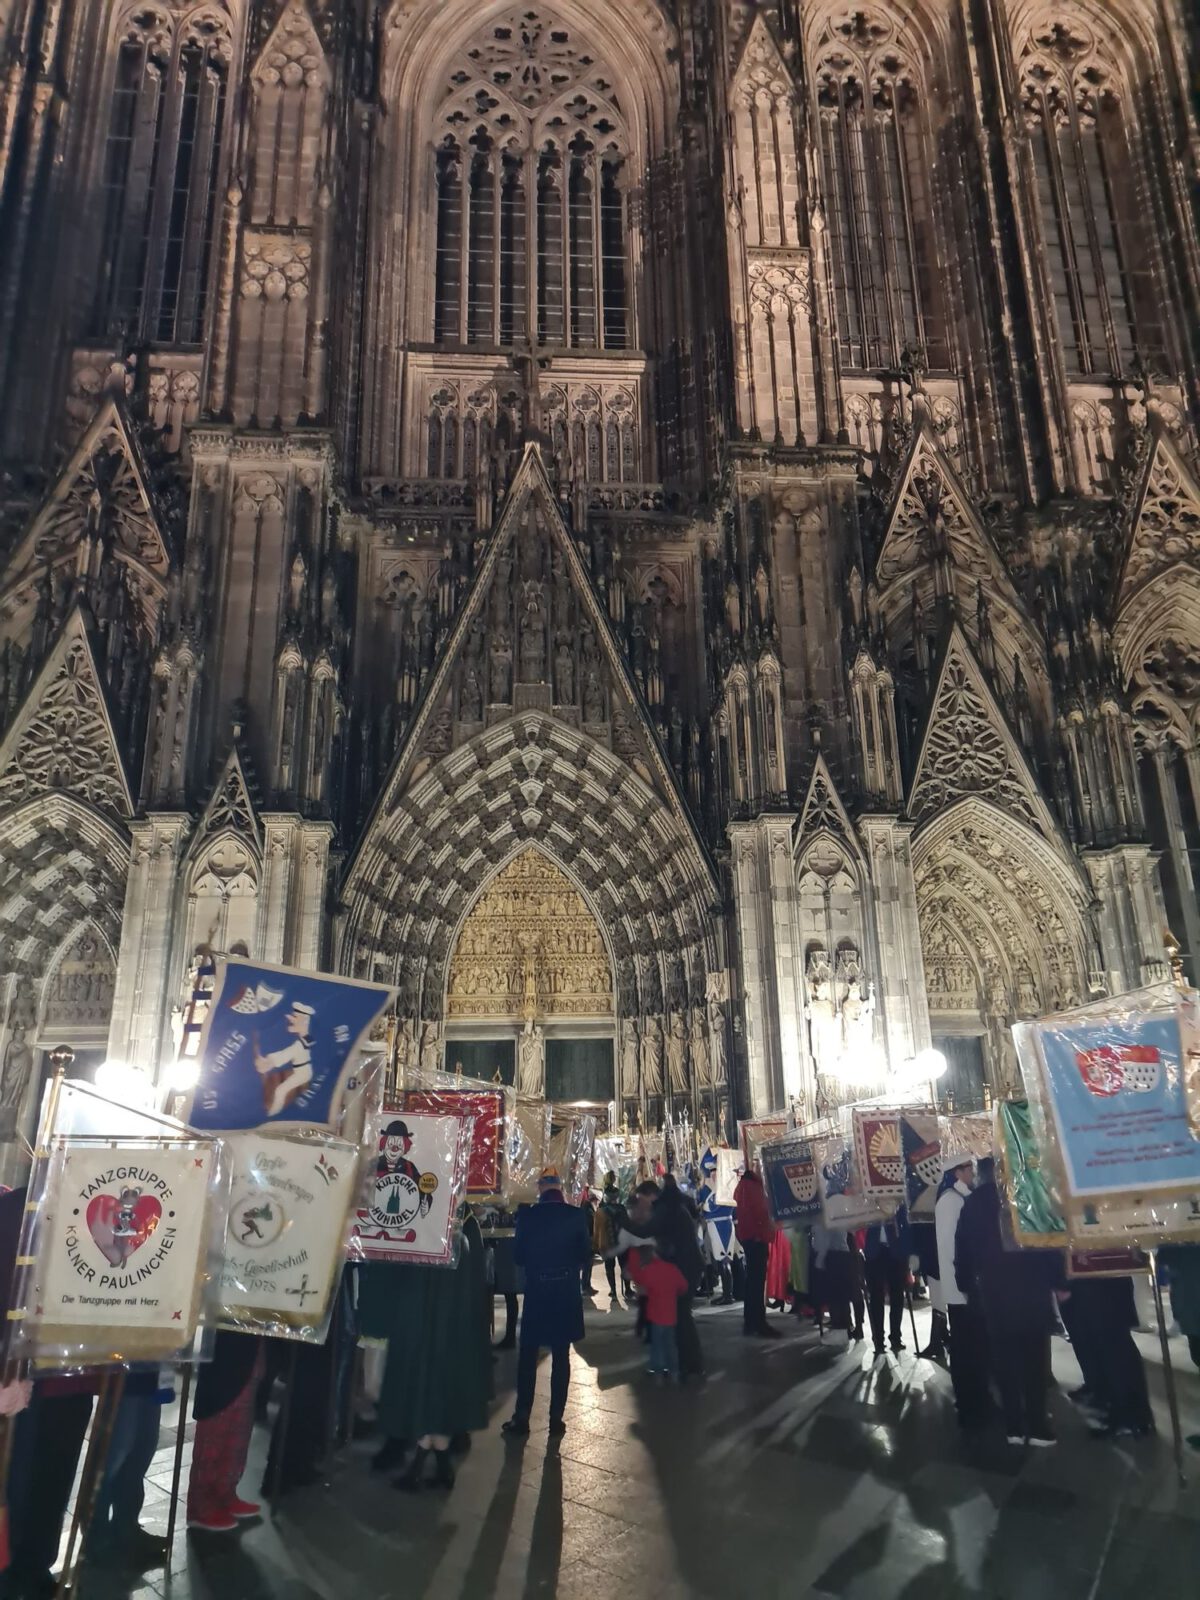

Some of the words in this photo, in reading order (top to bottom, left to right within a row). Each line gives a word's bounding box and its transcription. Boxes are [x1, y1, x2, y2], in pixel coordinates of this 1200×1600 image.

[79, 1166, 173, 1202] TANZGRUPPE
[371, 1206, 415, 1226] HUHADEL
[65, 1224, 96, 1283] KÖLNER
[99, 1226, 177, 1289] PAULINCHEN
[61, 1294, 75, 1304] Die
[78, 1295, 122, 1307] Tanzgruppe
[124, 1296, 138, 1306] mit
[140, 1297, 159, 1307] Herz
